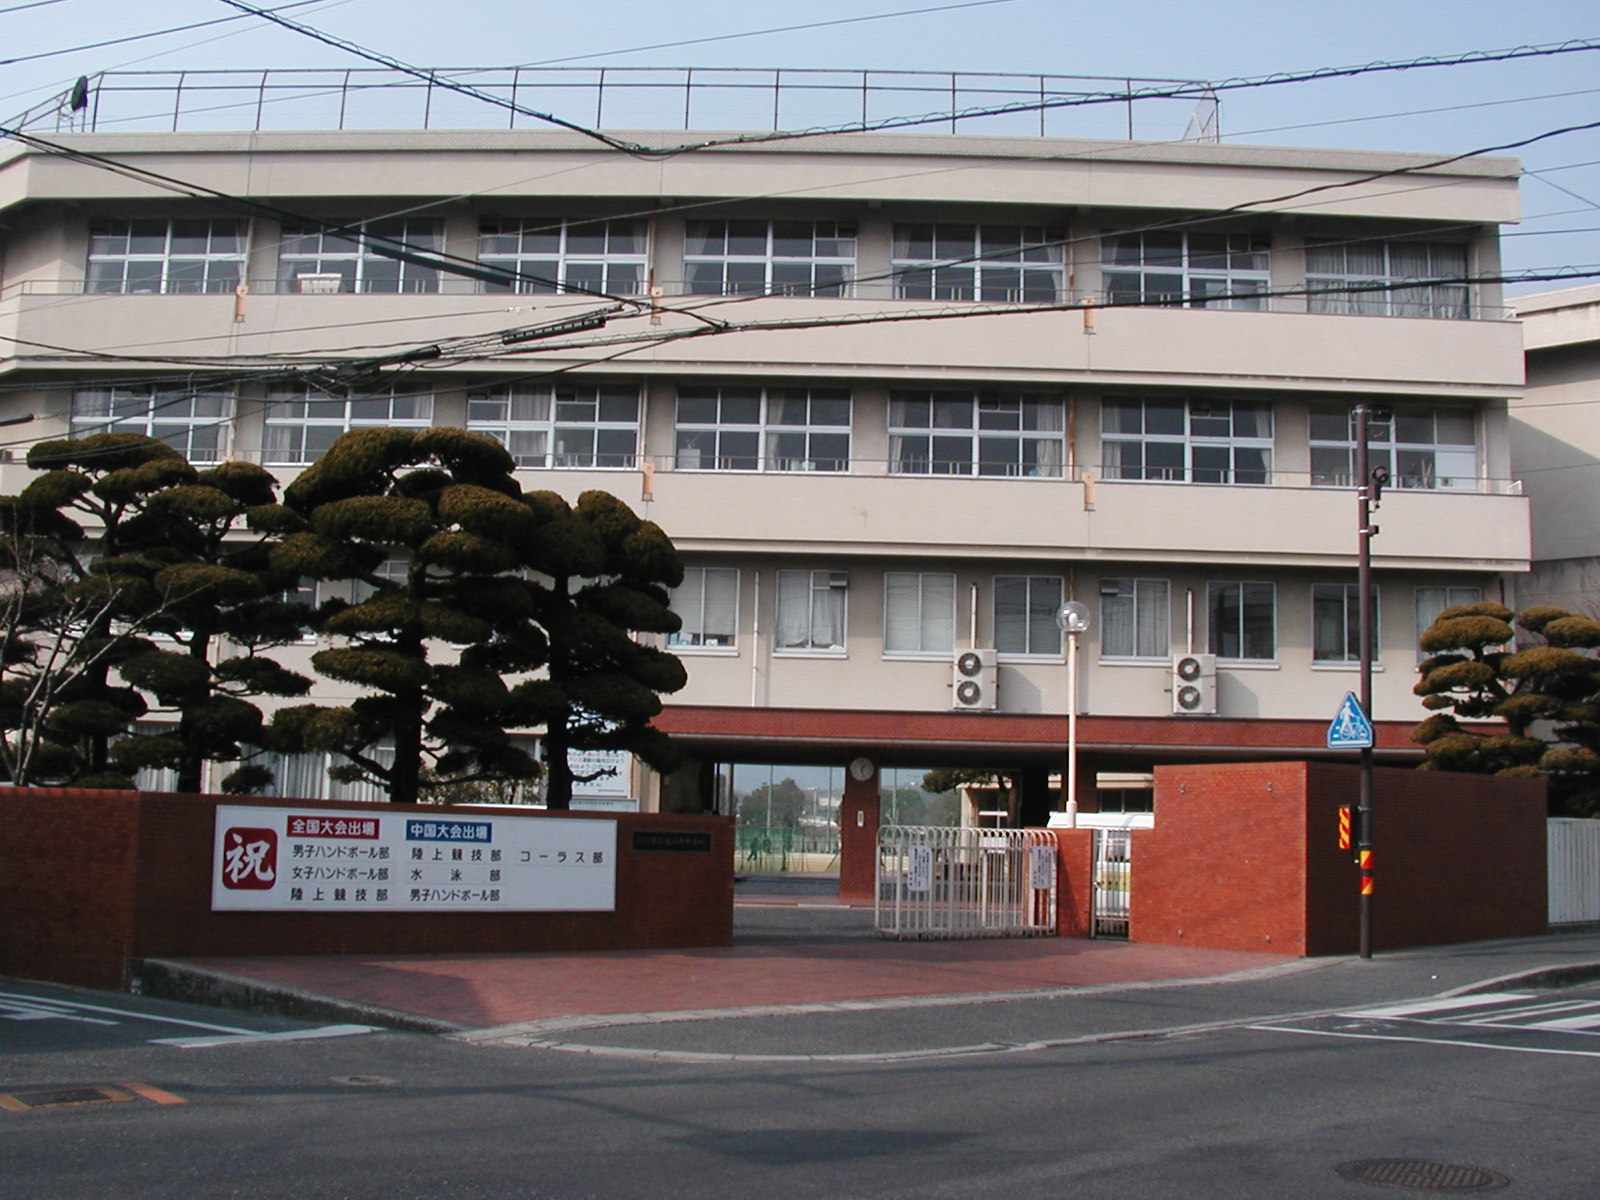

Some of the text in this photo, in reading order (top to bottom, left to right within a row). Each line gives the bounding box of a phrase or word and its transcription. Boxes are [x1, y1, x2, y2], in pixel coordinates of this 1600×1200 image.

[292, 819, 375, 836] 全国大会出場
[411, 823, 488, 840] 中国大会出場
[225, 833, 275, 884] 祝
[293, 845, 390, 859] 男子ハンドボール部
[412, 847, 501, 862] 陸上競技部
[520, 851, 603, 864] コーラス部
[292, 867, 389, 881] 女子ハンドボール部
[411, 868, 500, 882] 水泳部
[290, 887, 388, 901] 陸上競技部
[410, 889, 500, 902] 男子ハンドボール部
